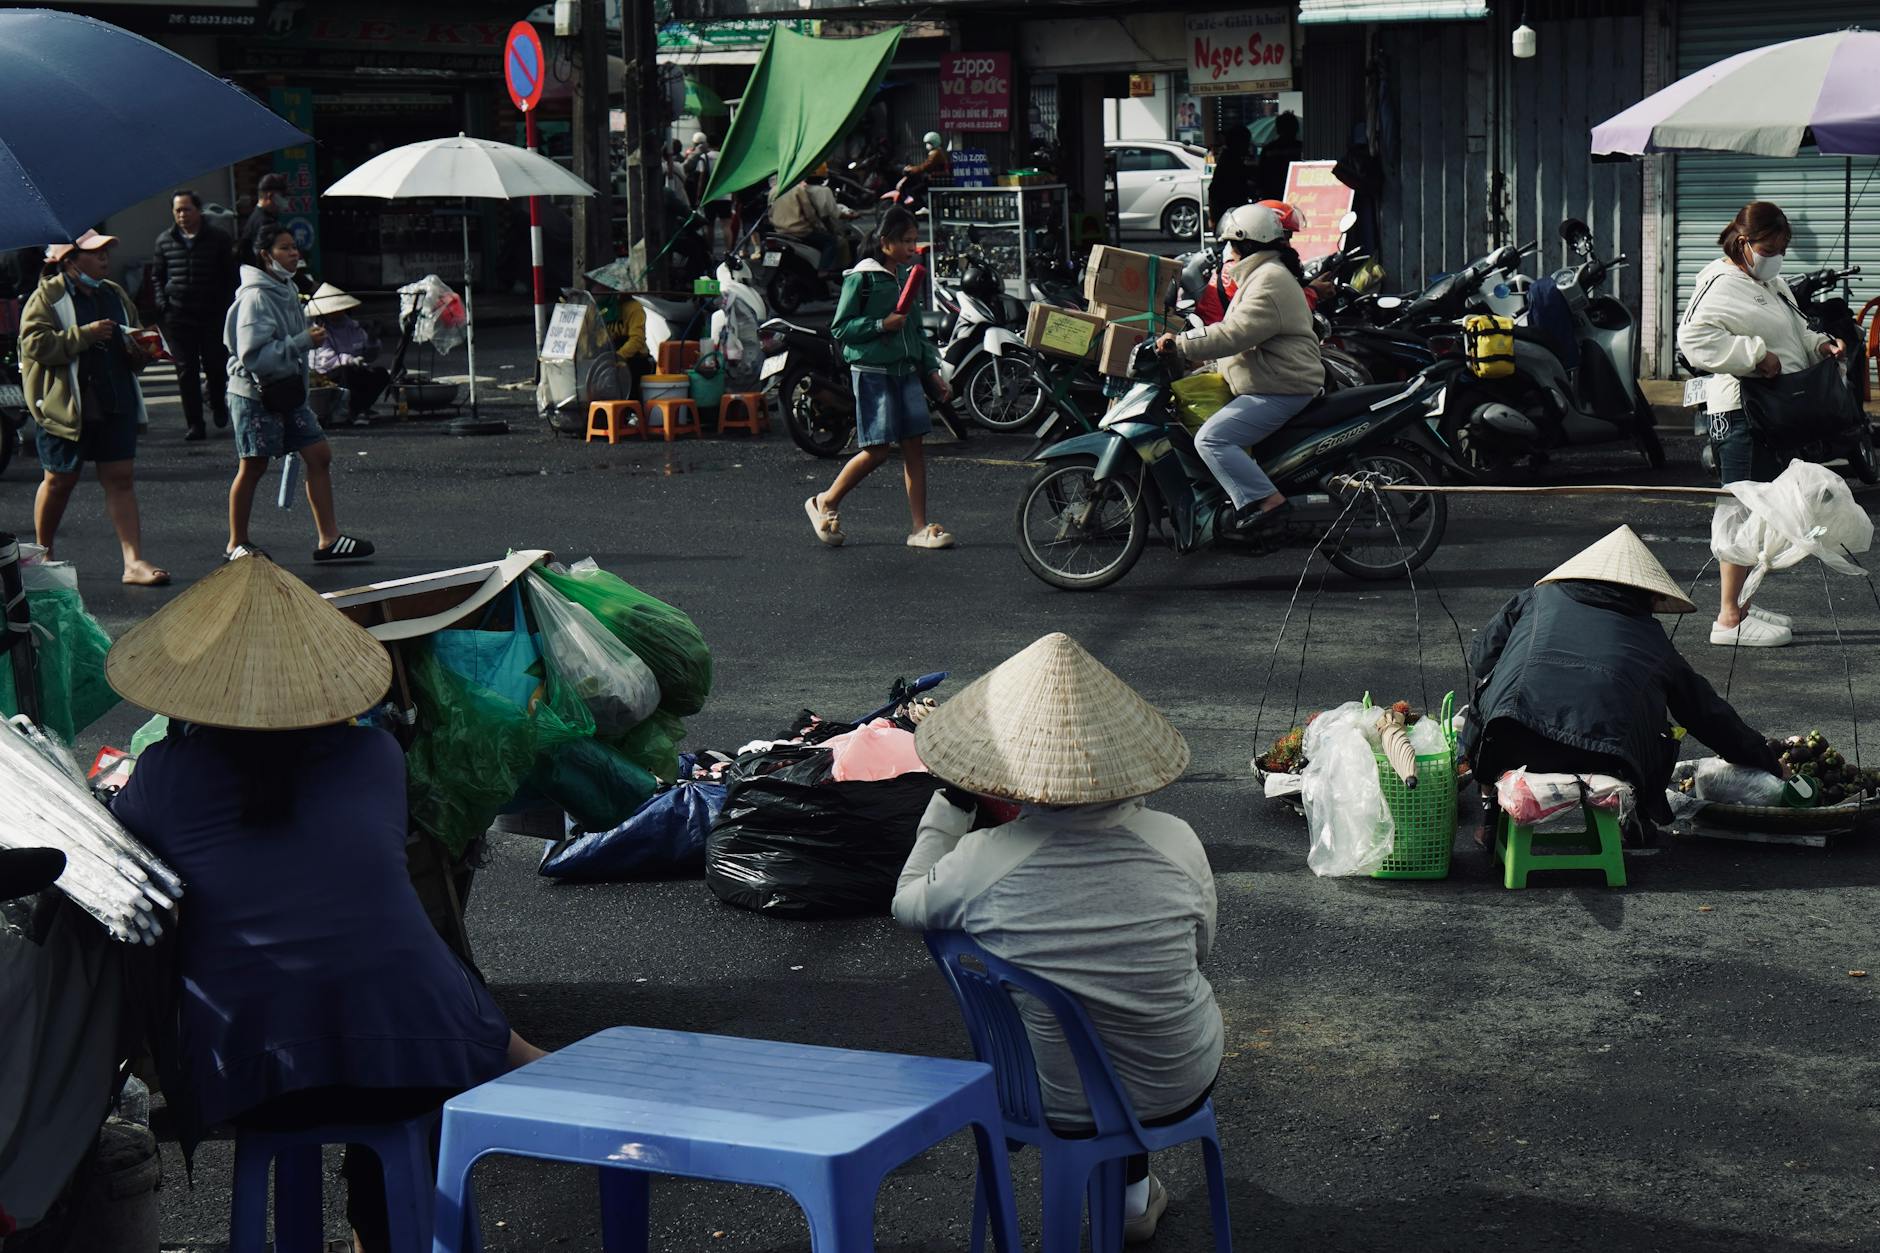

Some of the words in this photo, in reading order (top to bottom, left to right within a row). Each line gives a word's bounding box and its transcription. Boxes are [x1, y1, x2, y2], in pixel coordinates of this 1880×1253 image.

[952, 57, 995, 78] zippo
[1194, 36, 1244, 81] Ngọc
[1248, 31, 1285, 66] Sao
